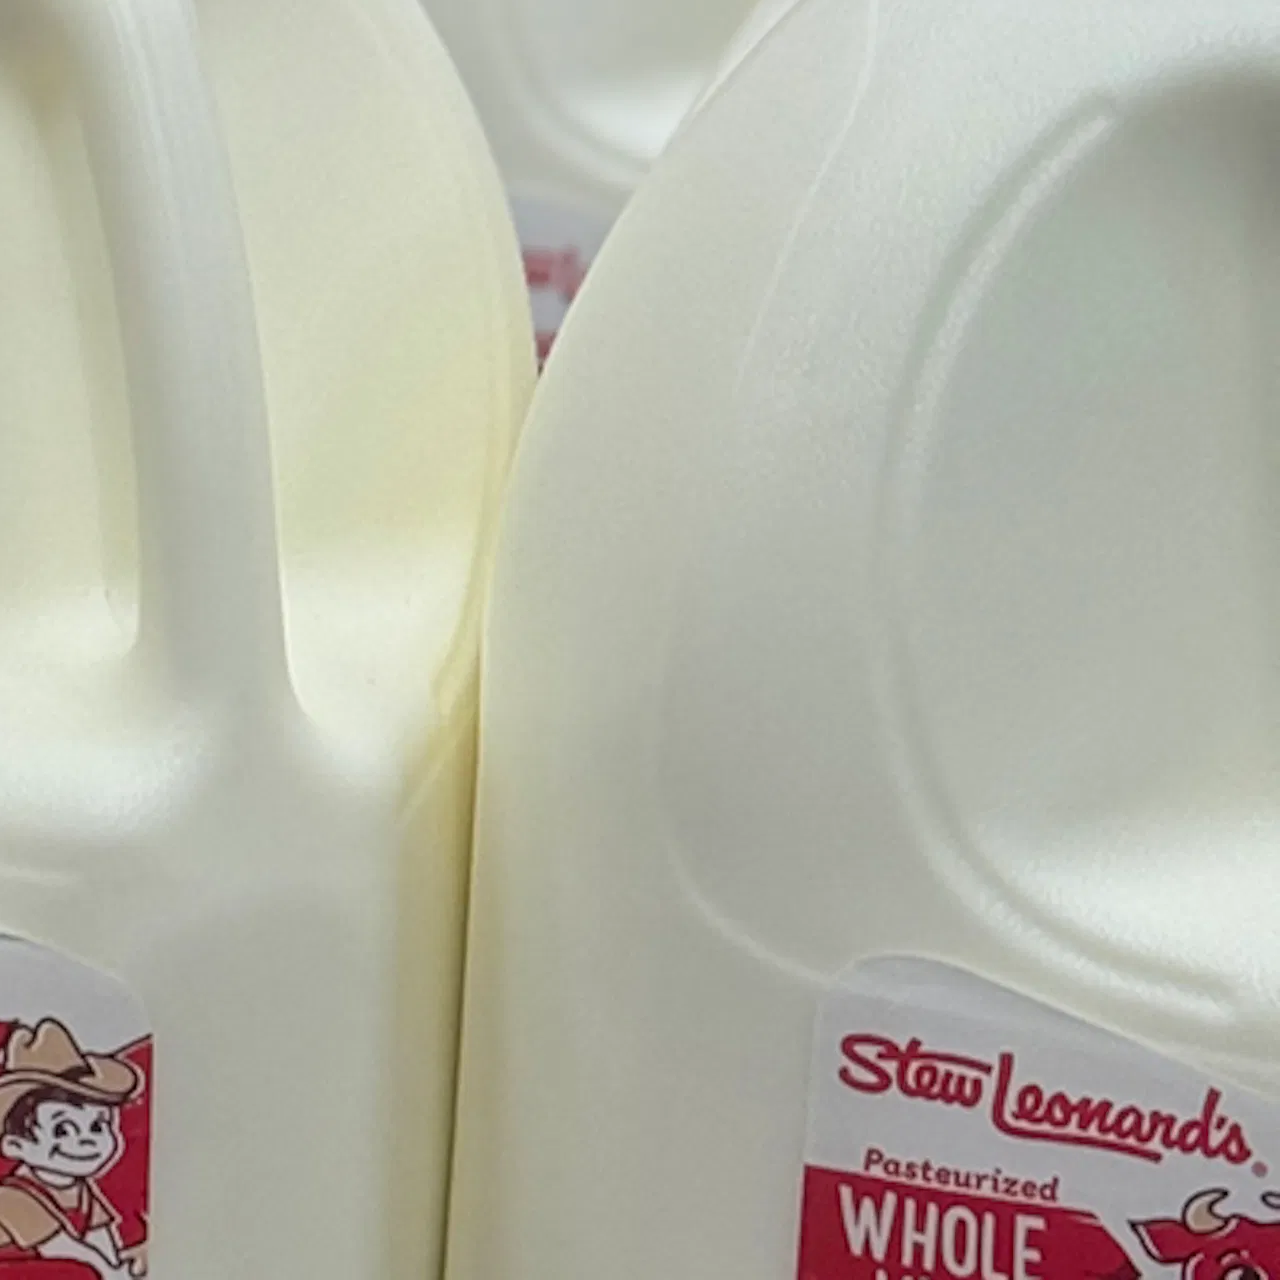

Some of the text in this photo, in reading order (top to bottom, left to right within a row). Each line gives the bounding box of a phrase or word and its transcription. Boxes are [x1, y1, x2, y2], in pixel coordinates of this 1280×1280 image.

[838, 1032, 1253, 1165] Stew Leonard's
[863, 1146, 1061, 1204] Pasteurized
[838, 1182, 1049, 1280] WHOLE
